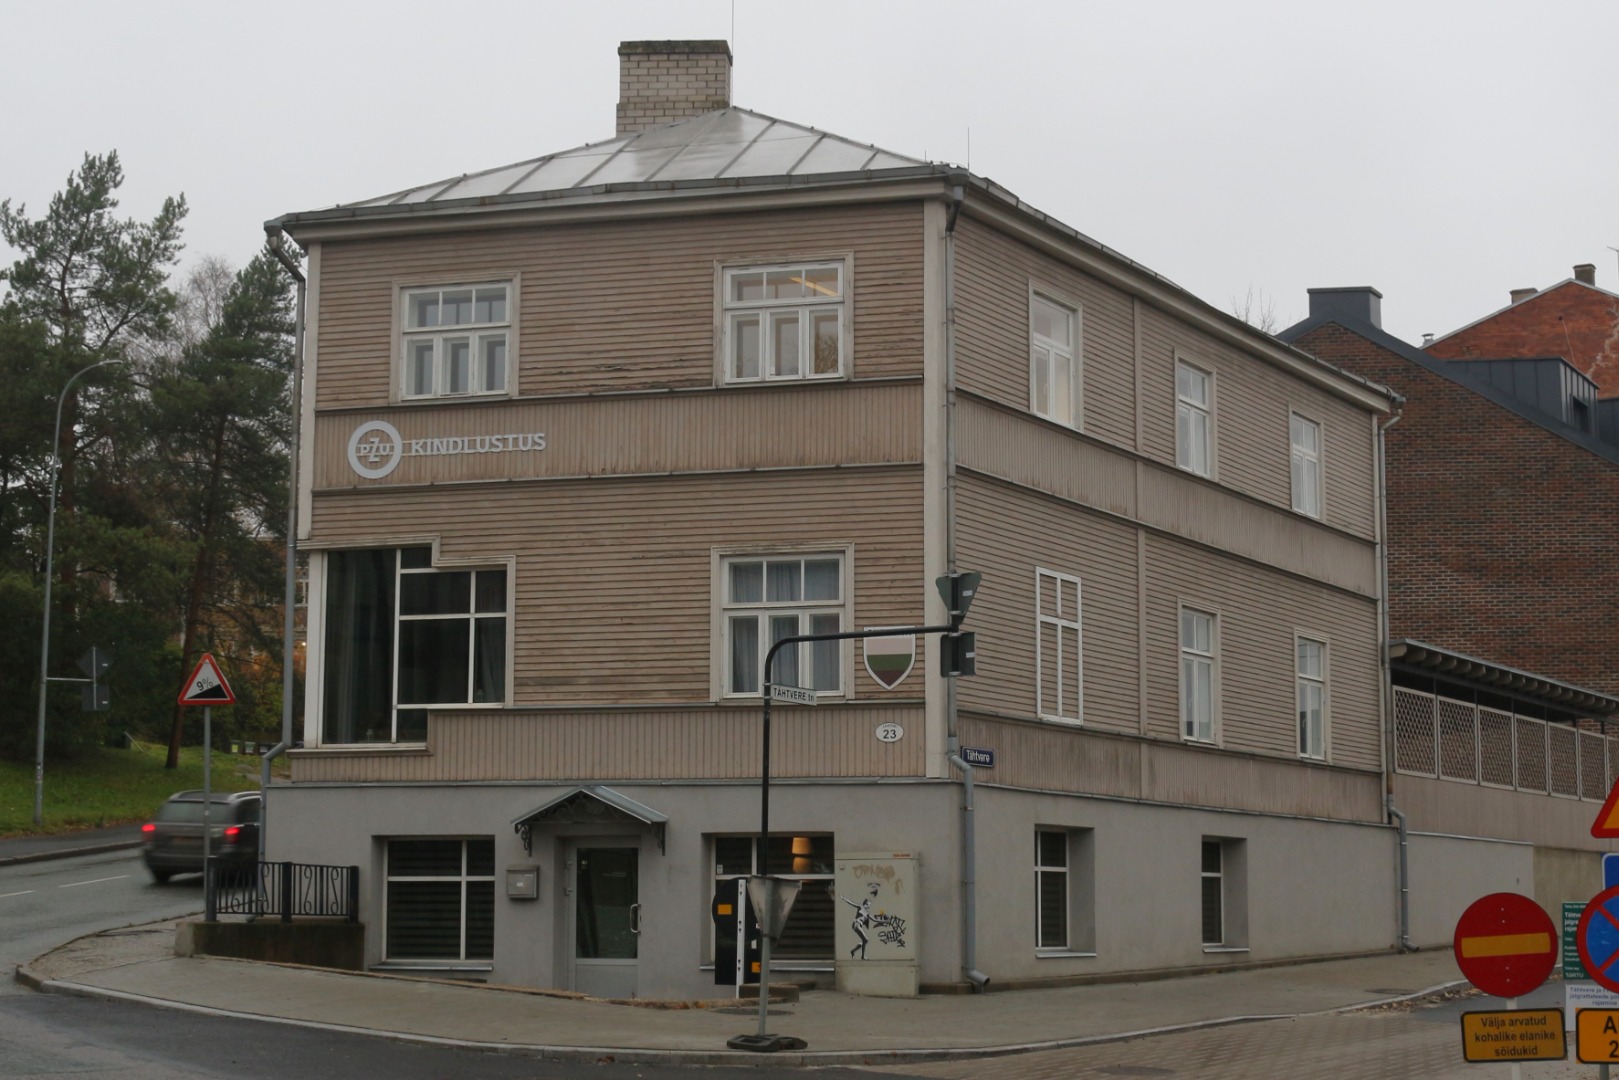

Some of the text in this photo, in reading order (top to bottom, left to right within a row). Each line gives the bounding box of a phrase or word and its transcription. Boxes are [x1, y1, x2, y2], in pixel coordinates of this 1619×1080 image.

[360, 432, 546, 462] PZU KINDLUSTUS
[196, 677, 214, 691] 9%
[883, 729, 897, 739] 23
[965, 749, 990, 763] Tähtvere
[1481, 1016, 1546, 1029] Välja arvatud
[1603, 1016, 1619, 1034] A
[1475, 1030, 1556, 1042] kohalike elanike
[1494, 1045, 1538, 1056] sõidukid
